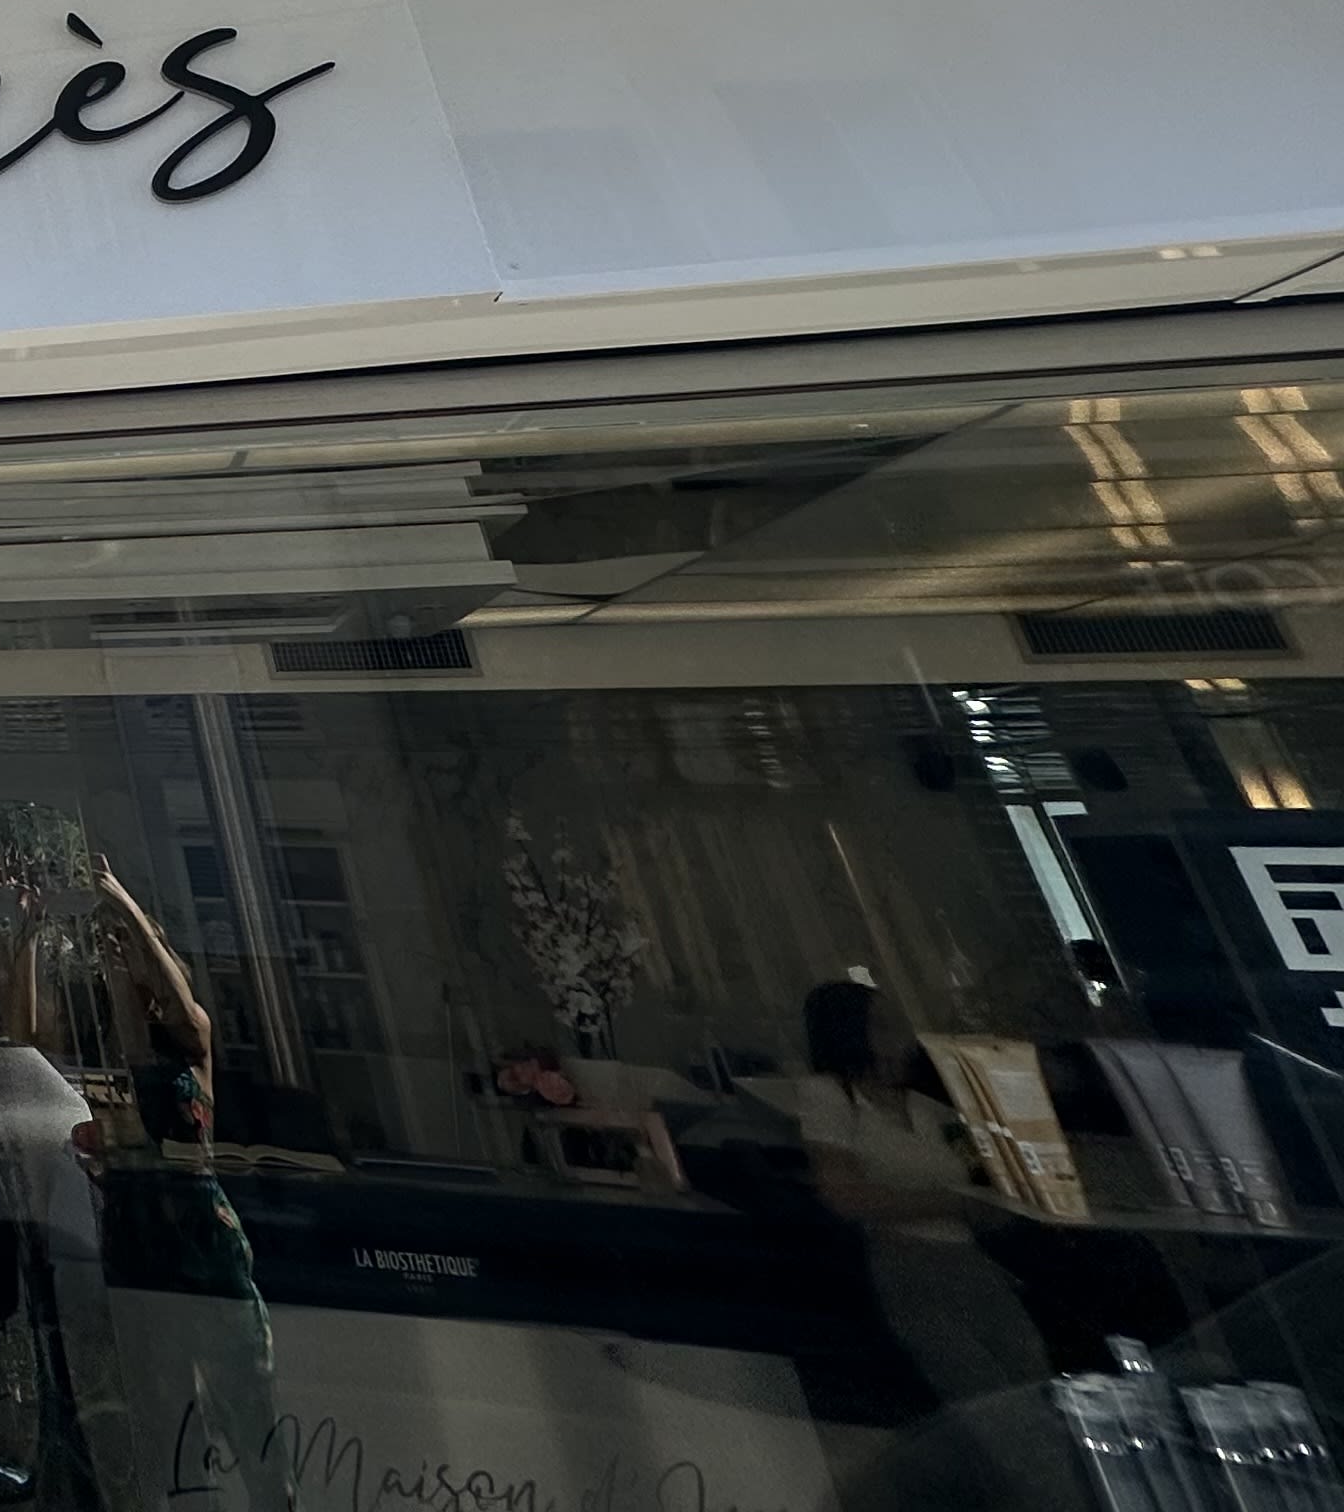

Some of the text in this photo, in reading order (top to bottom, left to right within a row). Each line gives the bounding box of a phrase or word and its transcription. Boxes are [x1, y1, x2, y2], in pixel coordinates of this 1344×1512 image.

[352, 1247, 480, 1278] LA BIOSTHETIQUE
[167, 1399, 241, 1498] La
